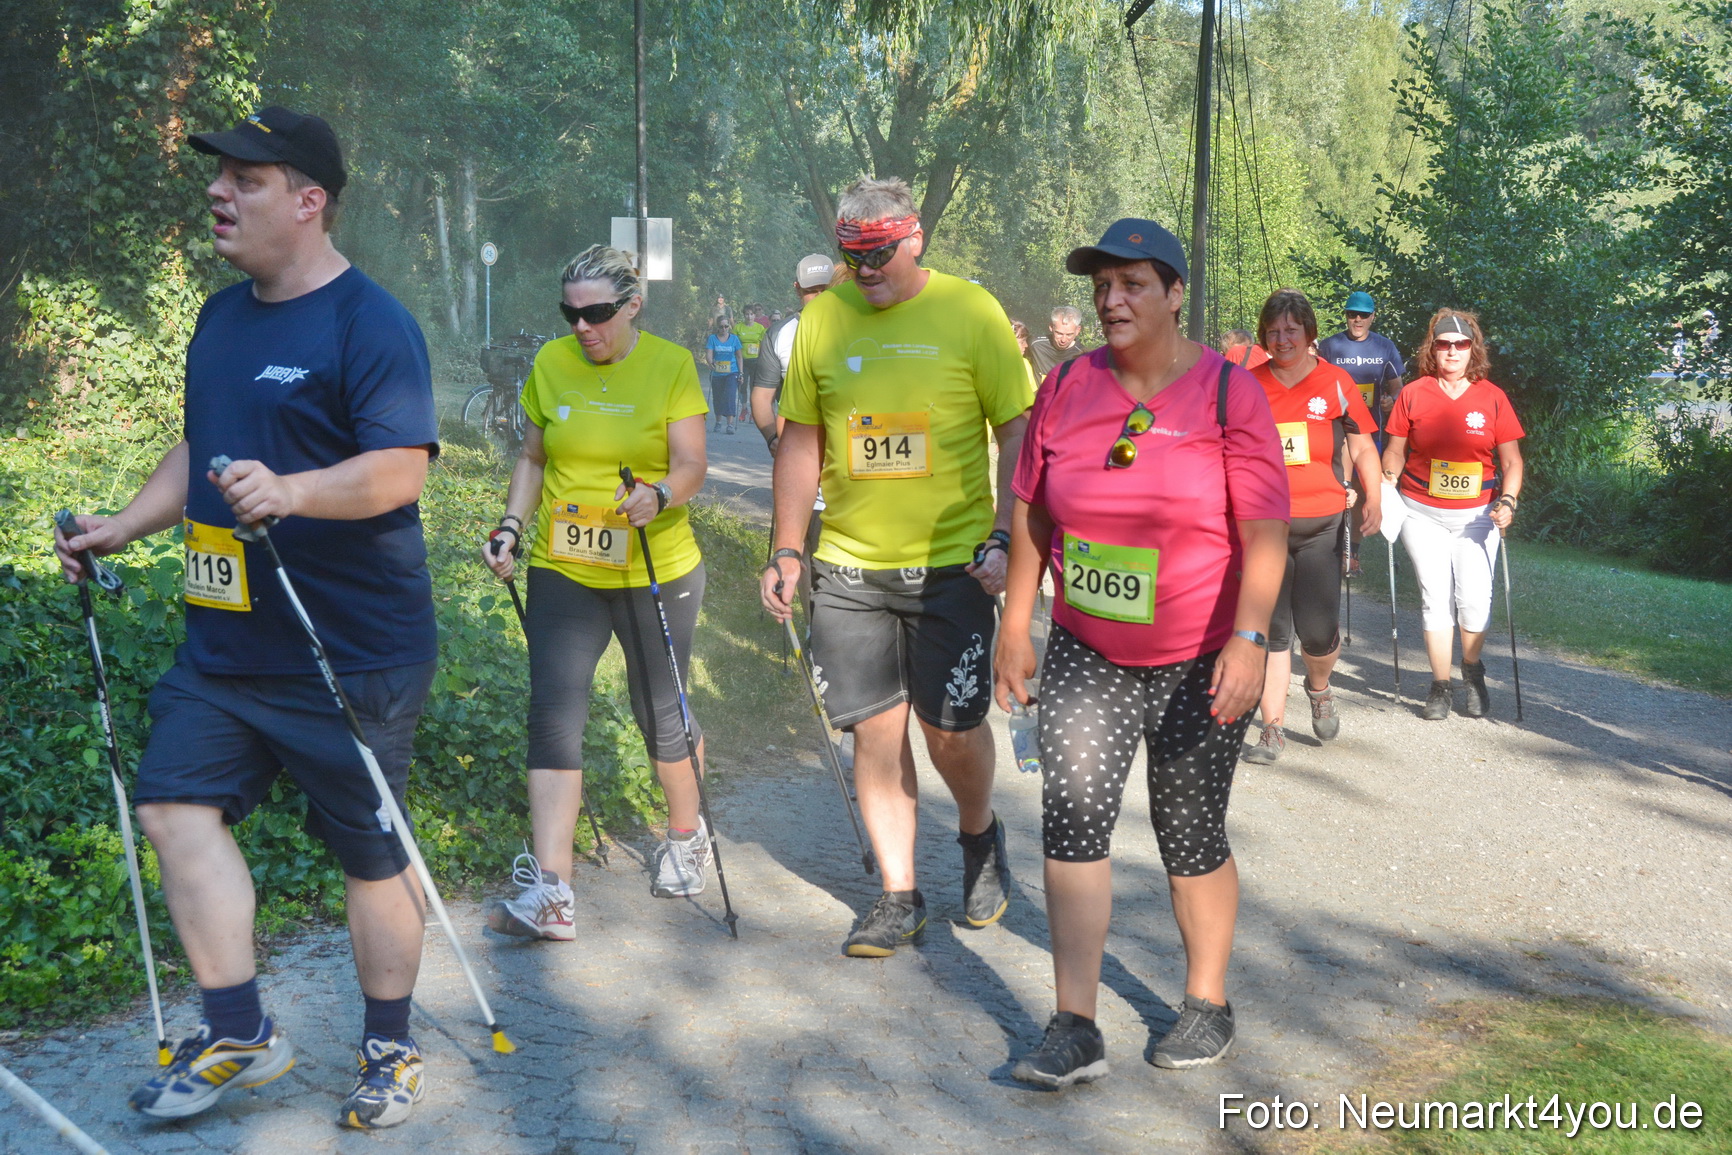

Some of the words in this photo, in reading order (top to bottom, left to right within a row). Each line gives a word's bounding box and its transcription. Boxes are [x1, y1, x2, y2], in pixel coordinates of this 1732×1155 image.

[1336, 357, 1356, 365] EURO
[1362, 357, 1384, 365] POLES
[864, 436, 912, 460] 914
[1440, 474, 1470, 489] 366
[567, 524, 613, 551] 910
[206, 585, 226, 594] Marco
[1071, 563, 1140, 601] 2069
